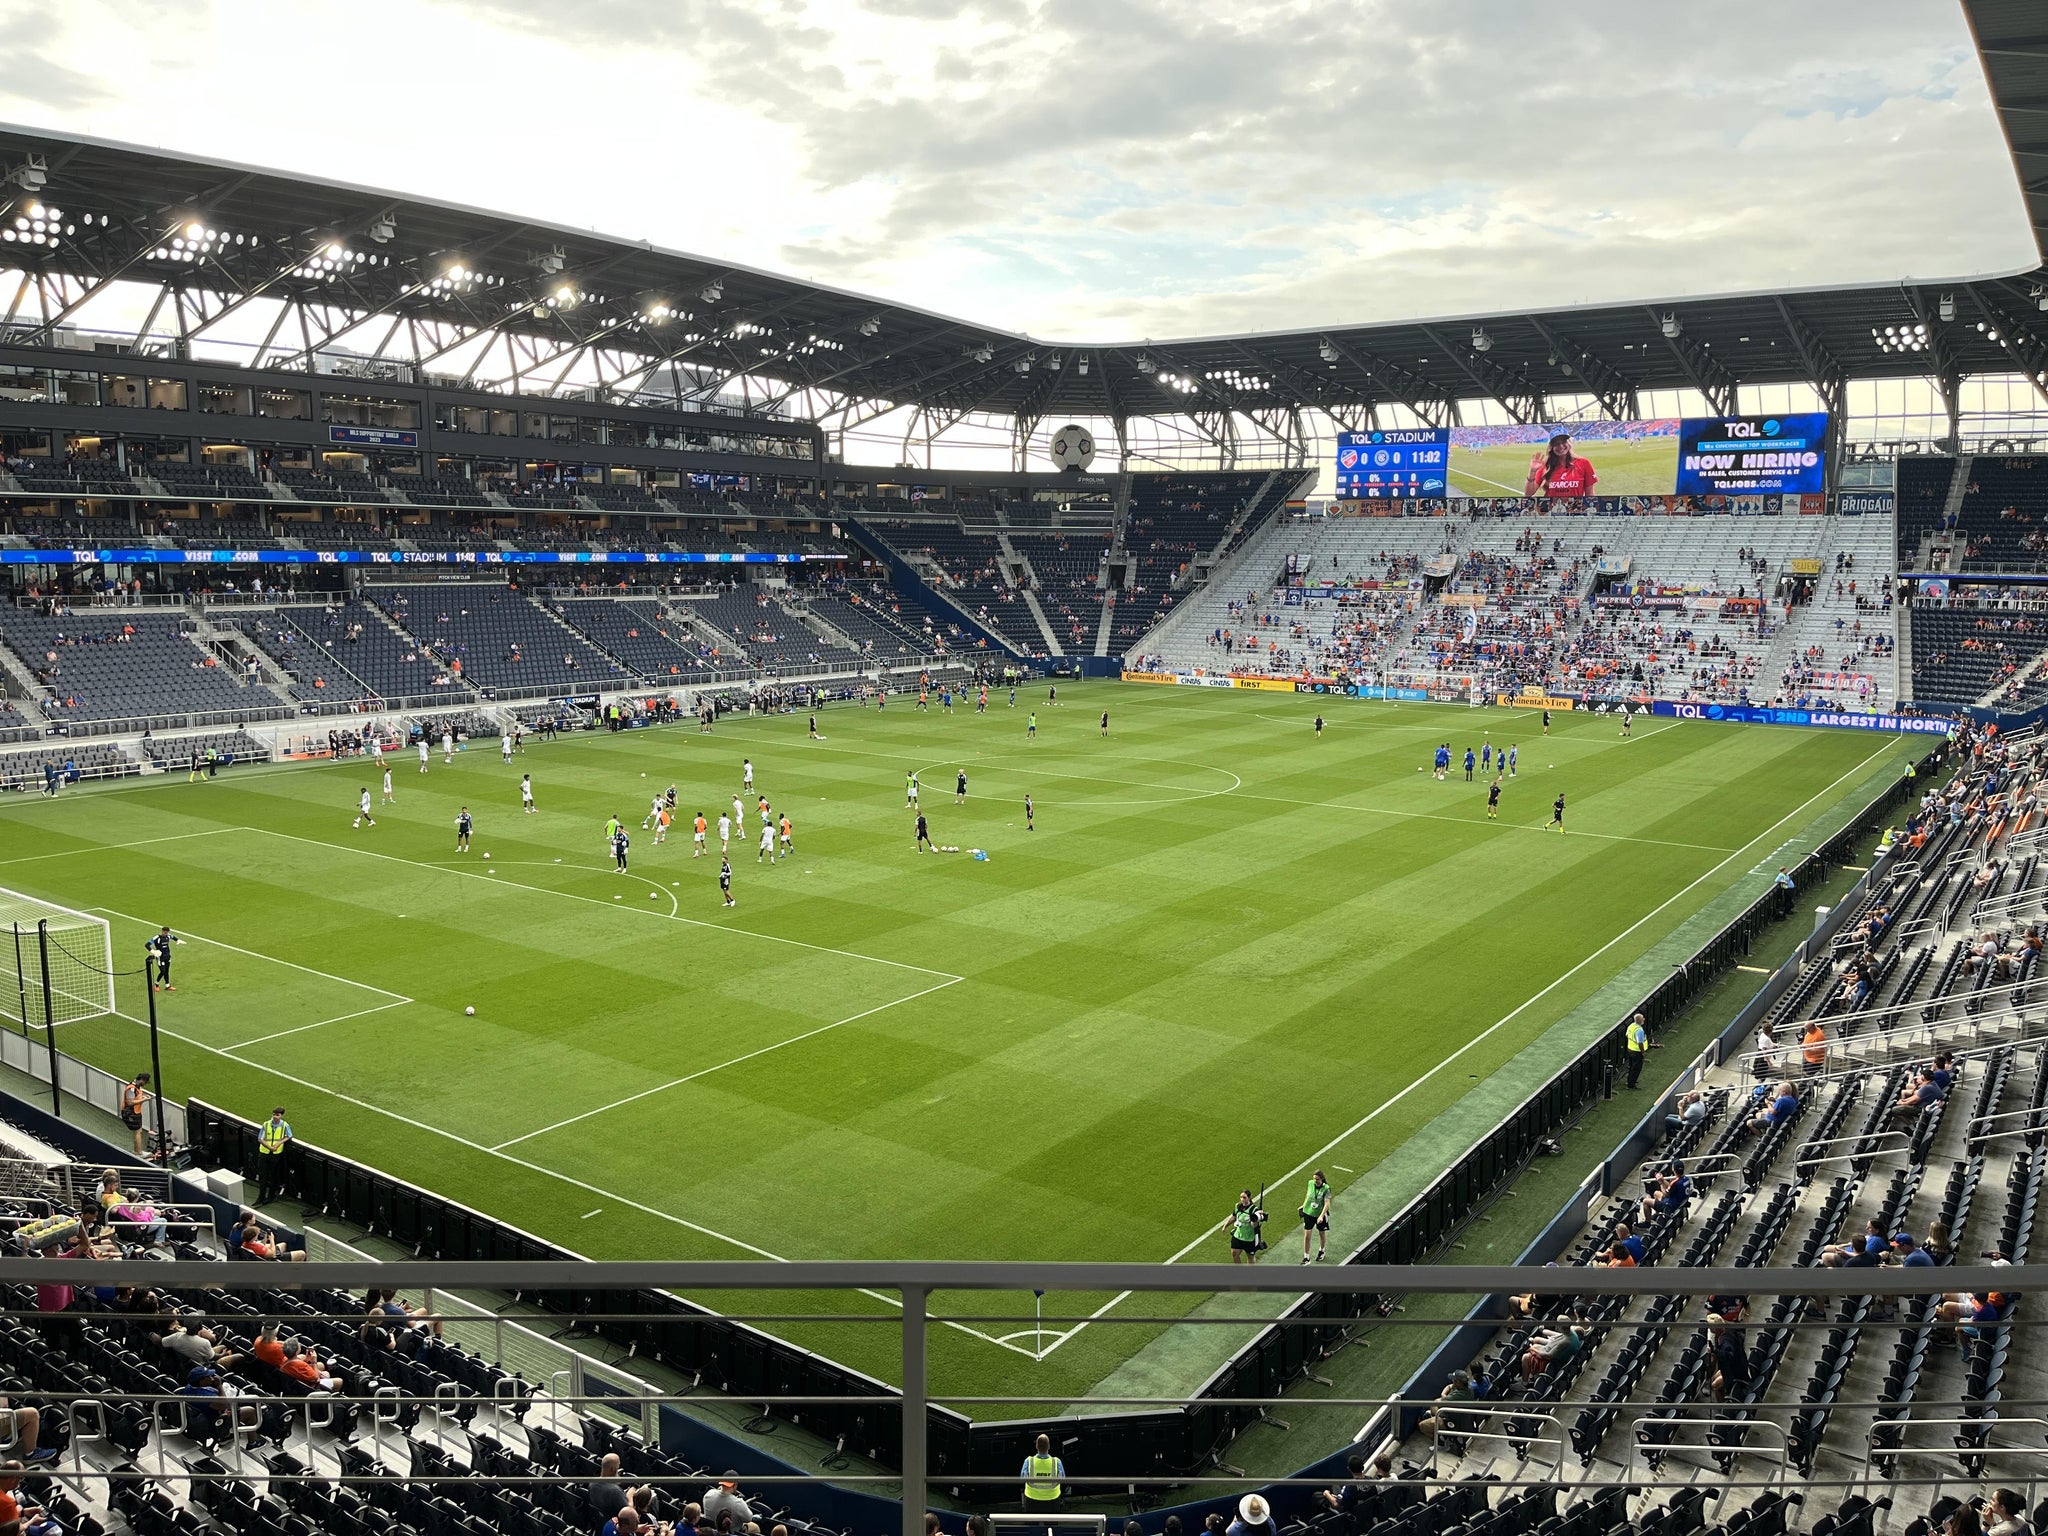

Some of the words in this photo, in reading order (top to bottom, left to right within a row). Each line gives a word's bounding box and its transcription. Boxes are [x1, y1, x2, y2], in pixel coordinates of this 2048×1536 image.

[1725, 422, 1761, 438] TQL
[1350, 433, 1372, 444] TQL
[1384, 431, 1436, 443] STADIUM
[1361, 452, 1368, 465] 0
[1393, 451, 1401, 464] 0
[1411, 450, 1441, 464] 11:02
[1684, 454, 1736, 470] NOW
[1741, 452, 1818, 469] HIRING
[1761, 468, 1786, 476] SERVICE
[1369, 473, 1380, 483] 0%
[1549, 480, 1579, 489] BEARCATS
[1714, 479, 1782, 489] TQLJOBS.COM
[1368, 487, 1380, 497] 0%
[73, 551, 99, 562] TQL
[317, 552, 338, 562] TQL
[371, 552, 391, 562] TQL
[403, 552, 447, 562] STADIUM
[455, 552, 476, 562] 11:02
[485, 553, 502, 562] TQL
[645, 554, 659, 562] TQL
[776, 554, 789, 562] TQL
[1596, 596, 1610, 604] THE
[1125, 671, 1156, 682] Continental
[1160, 674, 1173, 682] Tire
[1297, 683, 1315, 693] TQL
[1328, 685, 1346, 695] TQL
[572, 696, 596, 704] STADIUM
[1551, 698, 1568, 708] Tire
[1673, 703, 1706, 719] TQL
[1775, 710, 1808, 723] 2ND
[1811, 713, 1877, 728] LARGEST
[1879, 716, 1897, 729] IN
[1900, 718, 1947, 732] NORTH
